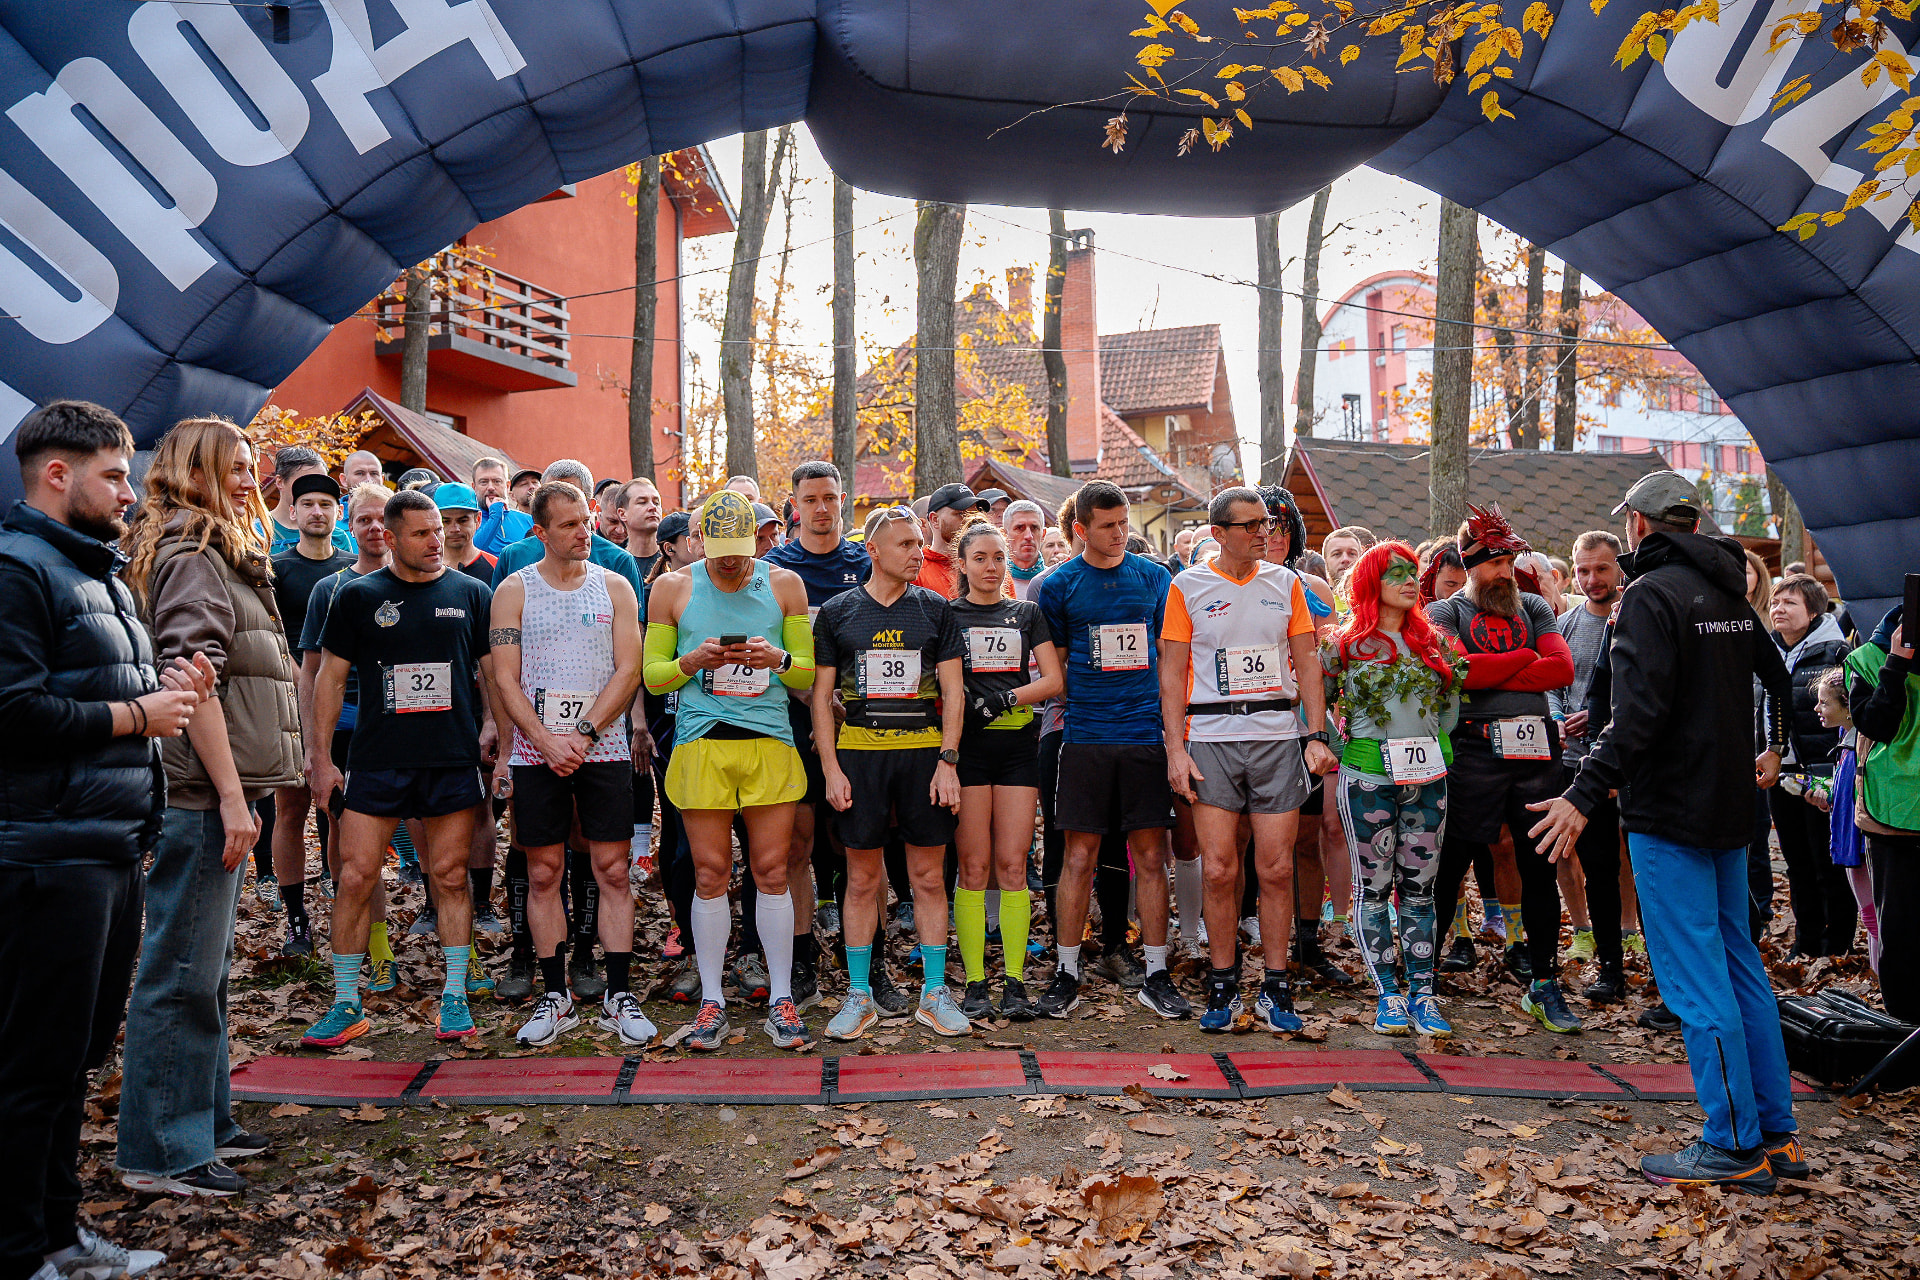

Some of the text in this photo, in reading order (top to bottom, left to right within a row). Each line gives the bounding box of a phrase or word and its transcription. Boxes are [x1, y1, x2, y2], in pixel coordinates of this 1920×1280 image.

[872, 628, 904, 643] MXT
[1694, 620, 1730, 635] TIMING
[984, 636, 1007, 653] 76
[1116, 634, 1137, 651] 12
[1093, 650, 1100, 659] 10
[881, 660, 905, 678] 38
[1242, 655, 1265, 673] 36
[410, 673, 436, 692] 32
[859, 676, 866, 685] 10
[1219, 674, 1228, 682] 10
[386, 691, 394, 701] 10
[559, 700, 584, 719] 37
[1516, 723, 1535, 740] 69
[1493, 738, 1501, 747] 10
[1404, 746, 1427, 764] 70
[1385, 763, 1392, 772] 10
